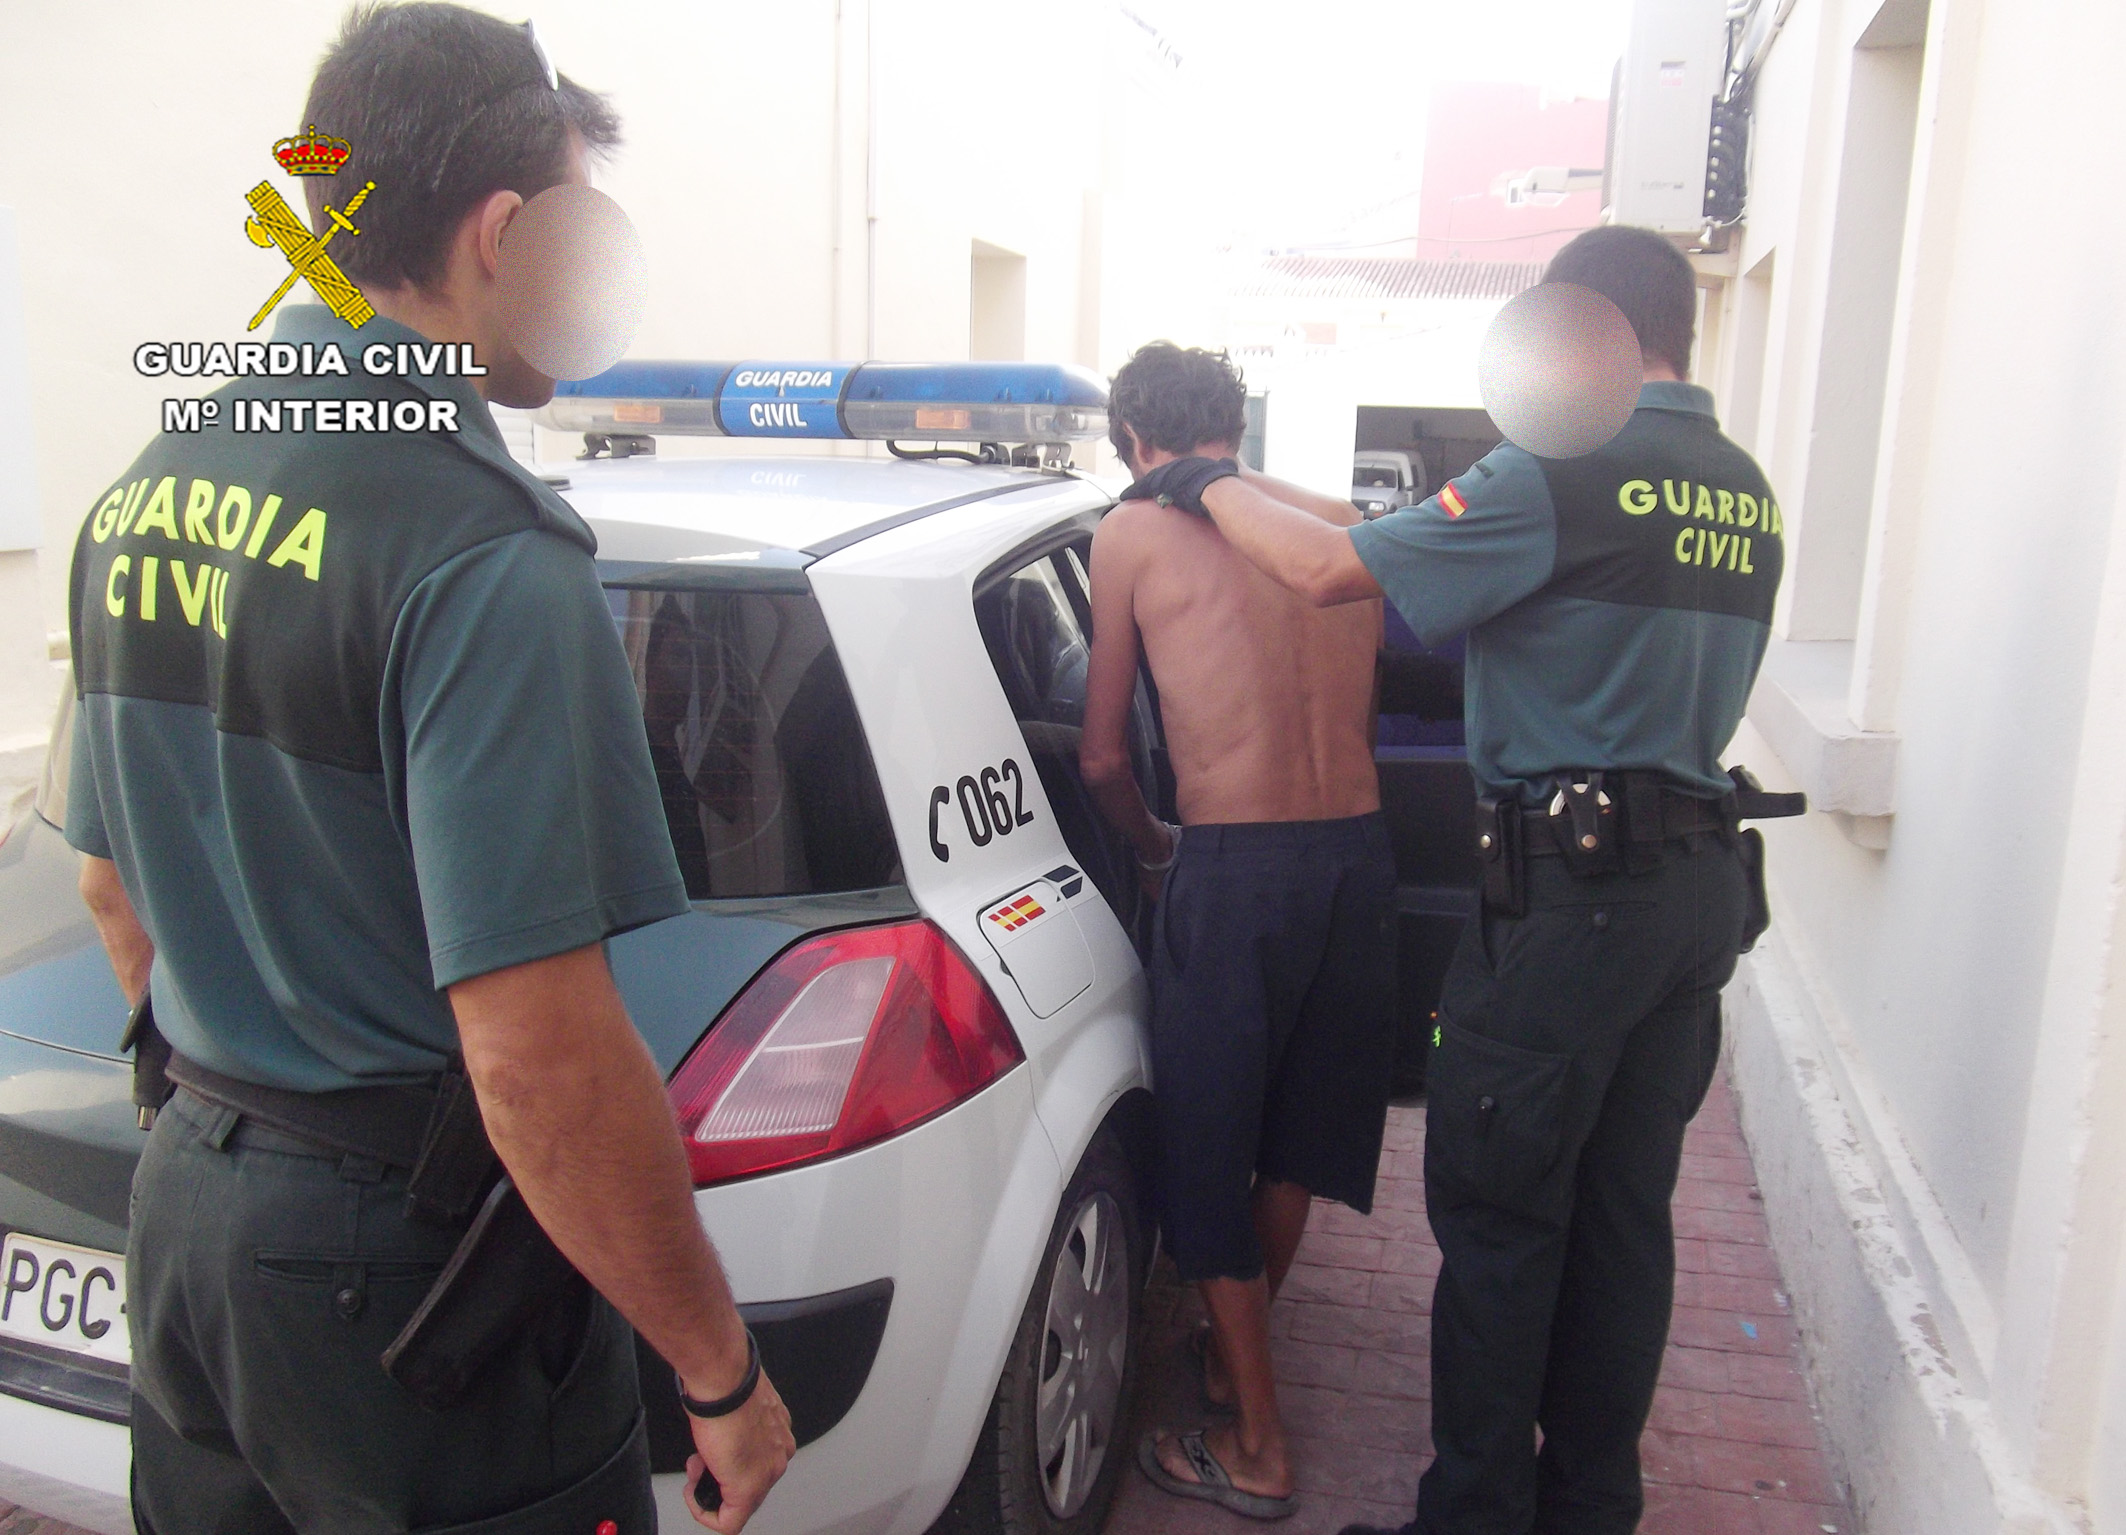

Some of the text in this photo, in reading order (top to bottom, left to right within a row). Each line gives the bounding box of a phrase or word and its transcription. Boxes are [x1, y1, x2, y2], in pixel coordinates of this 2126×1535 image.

[735, 370, 833, 388] GUARDIA
[749, 402, 808, 428] CIVIL
[92, 475, 327, 582] GUARDIA
[1618, 478, 1784, 538] GUARDIA
[1675, 526, 1755, 574] CIVIL
[106, 554, 230, 641] CIVIL
[956, 758, 1035, 847] 062
